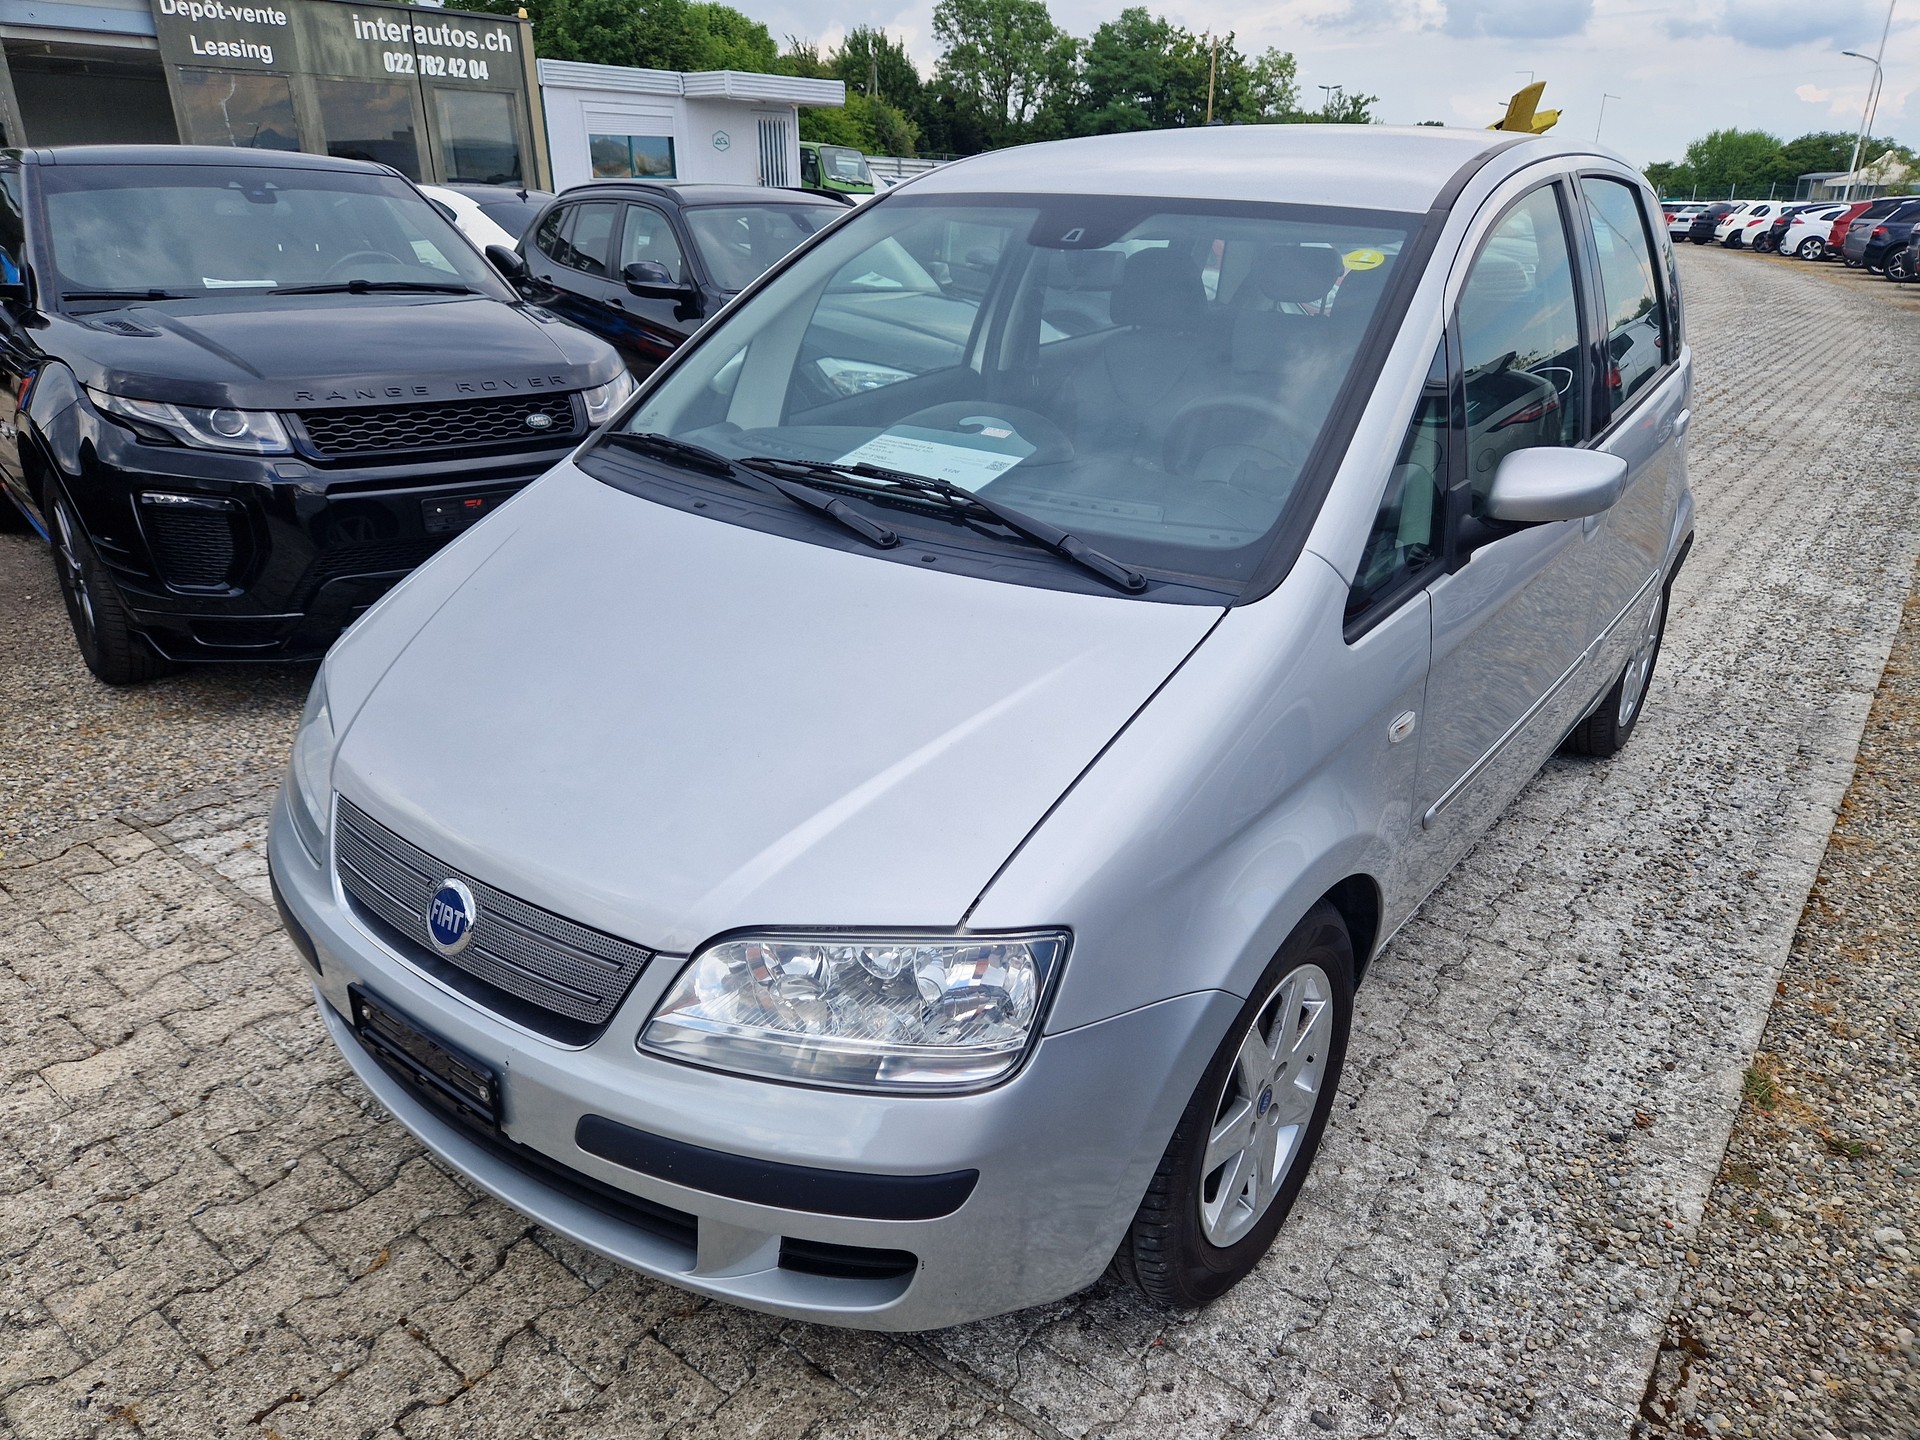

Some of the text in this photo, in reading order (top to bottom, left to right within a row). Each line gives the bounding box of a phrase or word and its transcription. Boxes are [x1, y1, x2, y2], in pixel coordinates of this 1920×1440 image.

[352, 14, 513, 53] interautos.ch
[189, 34, 274, 64] Leasing
[383, 52, 489, 80] 022 782 42 04
[294, 375, 566, 401] RANGE ROVER
[430, 898, 464, 934] FIAT
